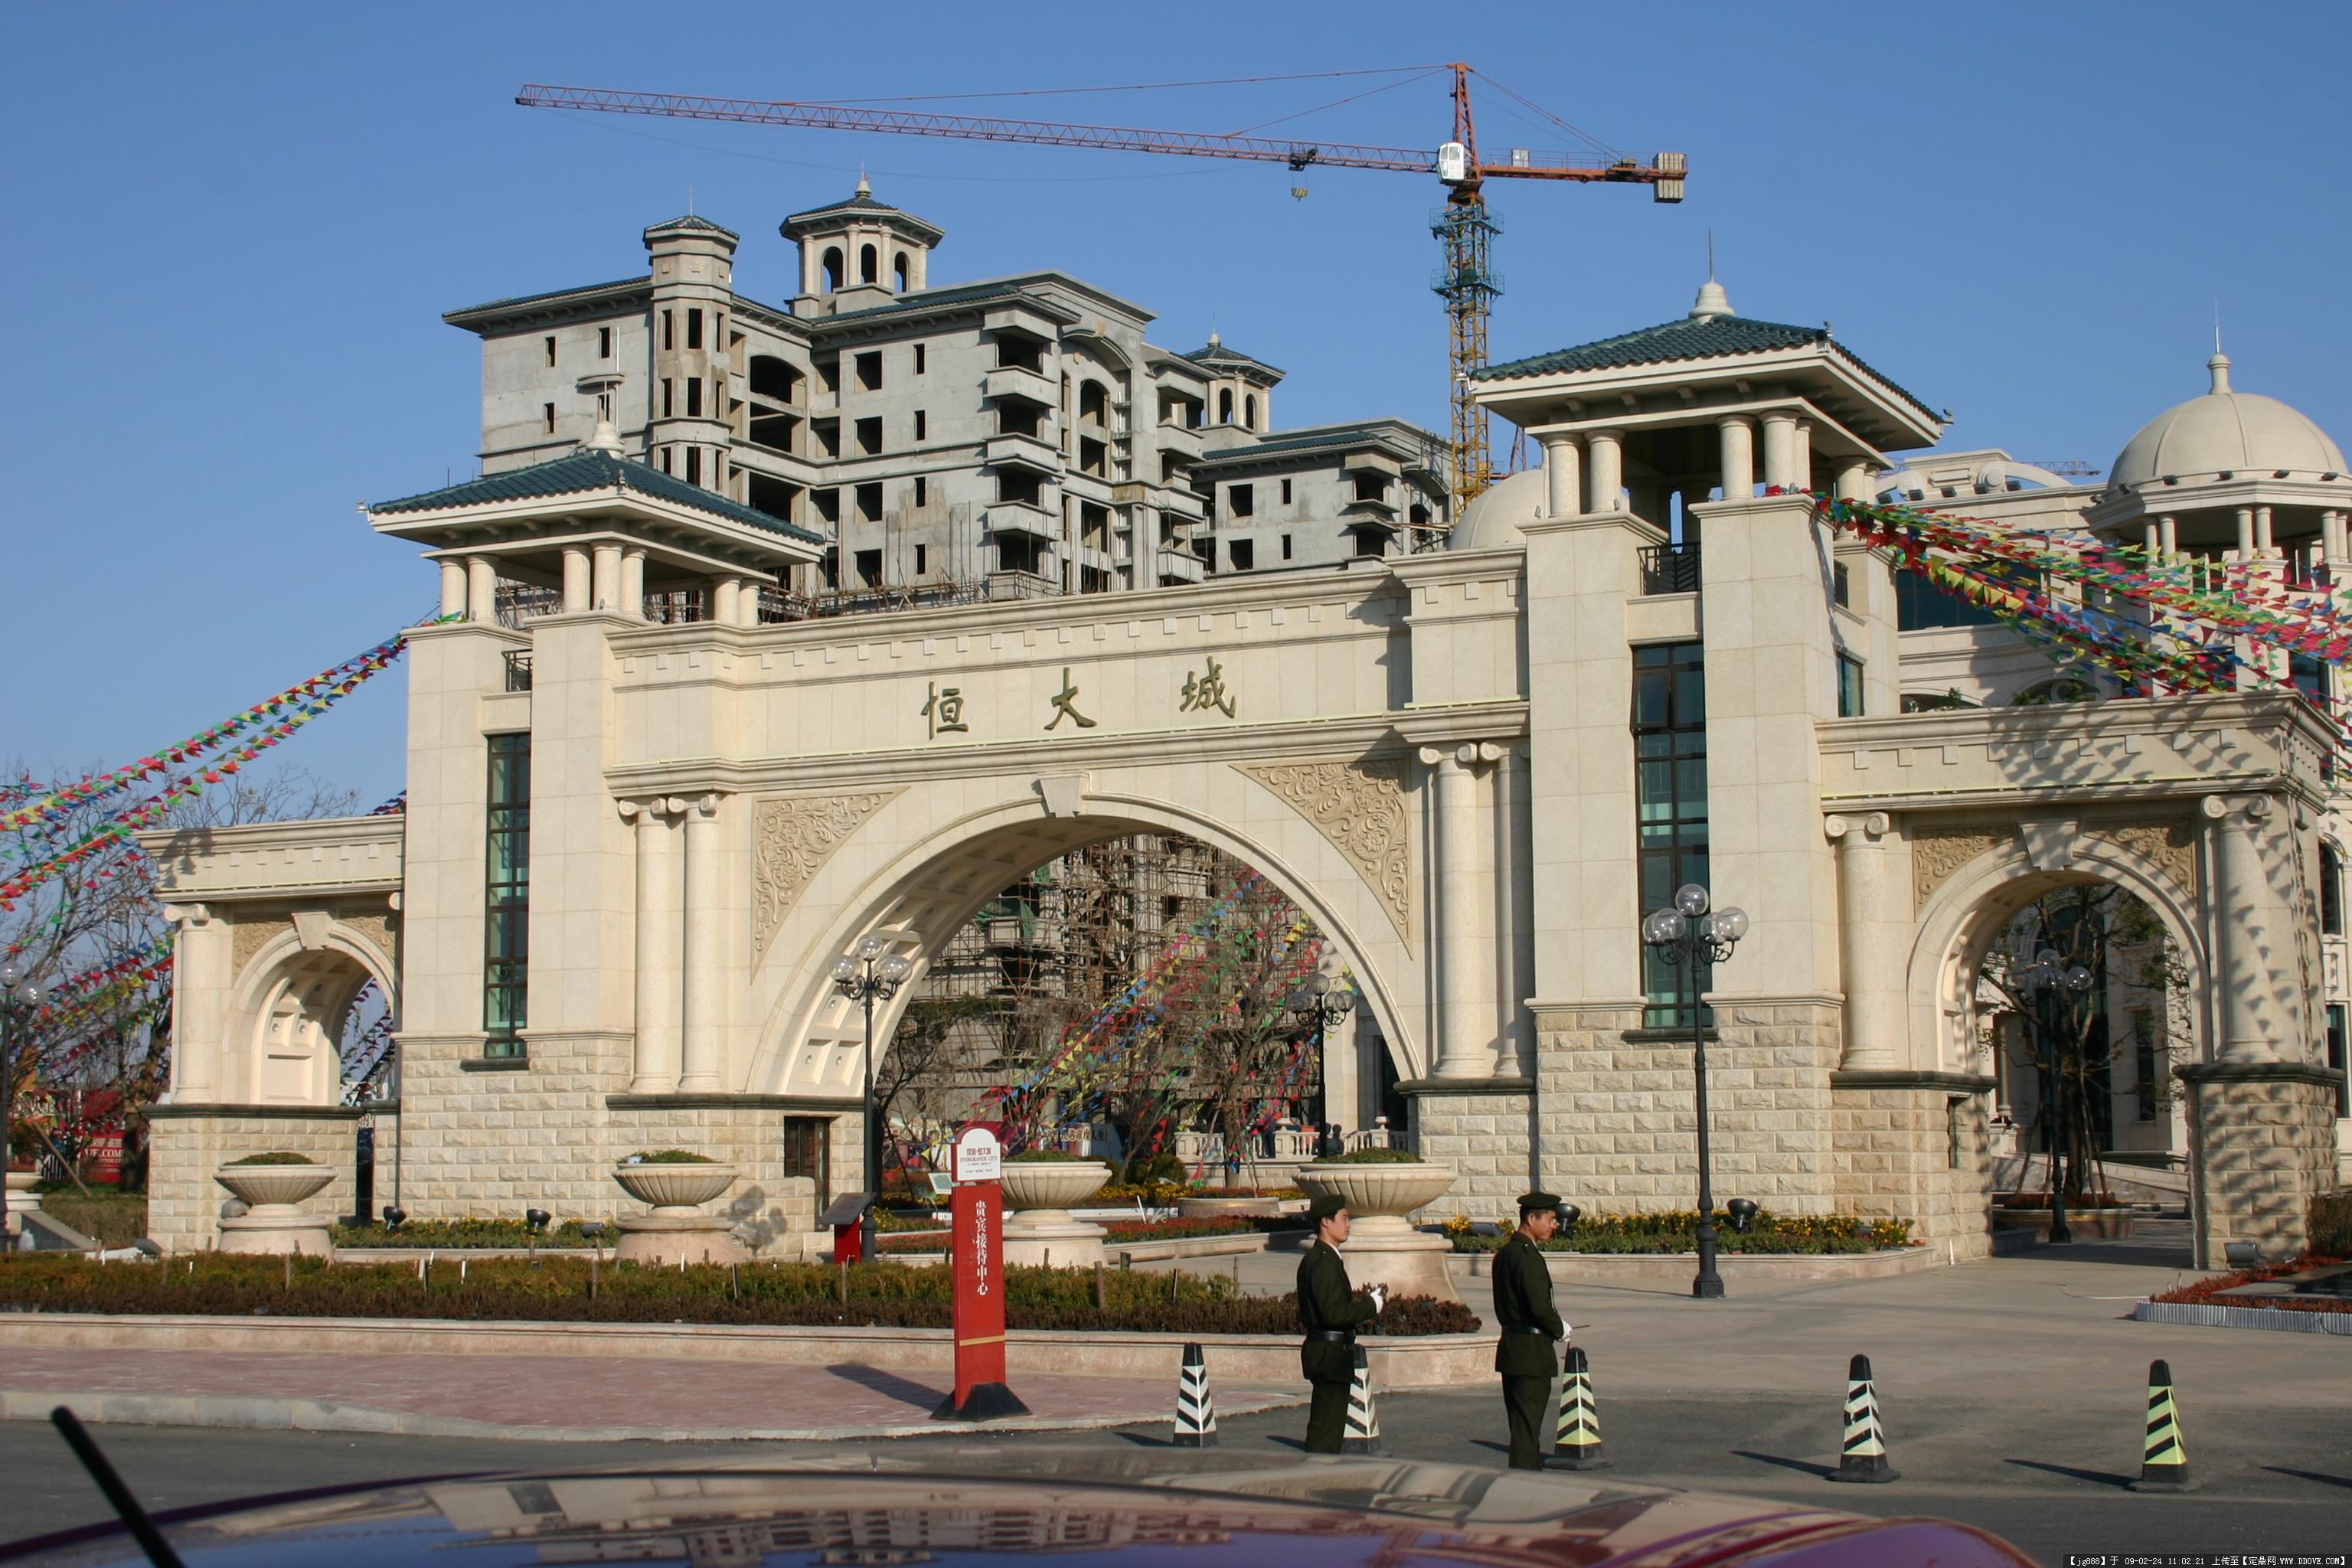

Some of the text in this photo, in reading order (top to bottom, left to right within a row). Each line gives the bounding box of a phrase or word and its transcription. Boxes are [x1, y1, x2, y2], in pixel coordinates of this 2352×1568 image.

[921, 655, 1239, 740] 恒大城
[975, 1200, 988, 1295] 贵宾接待中心
